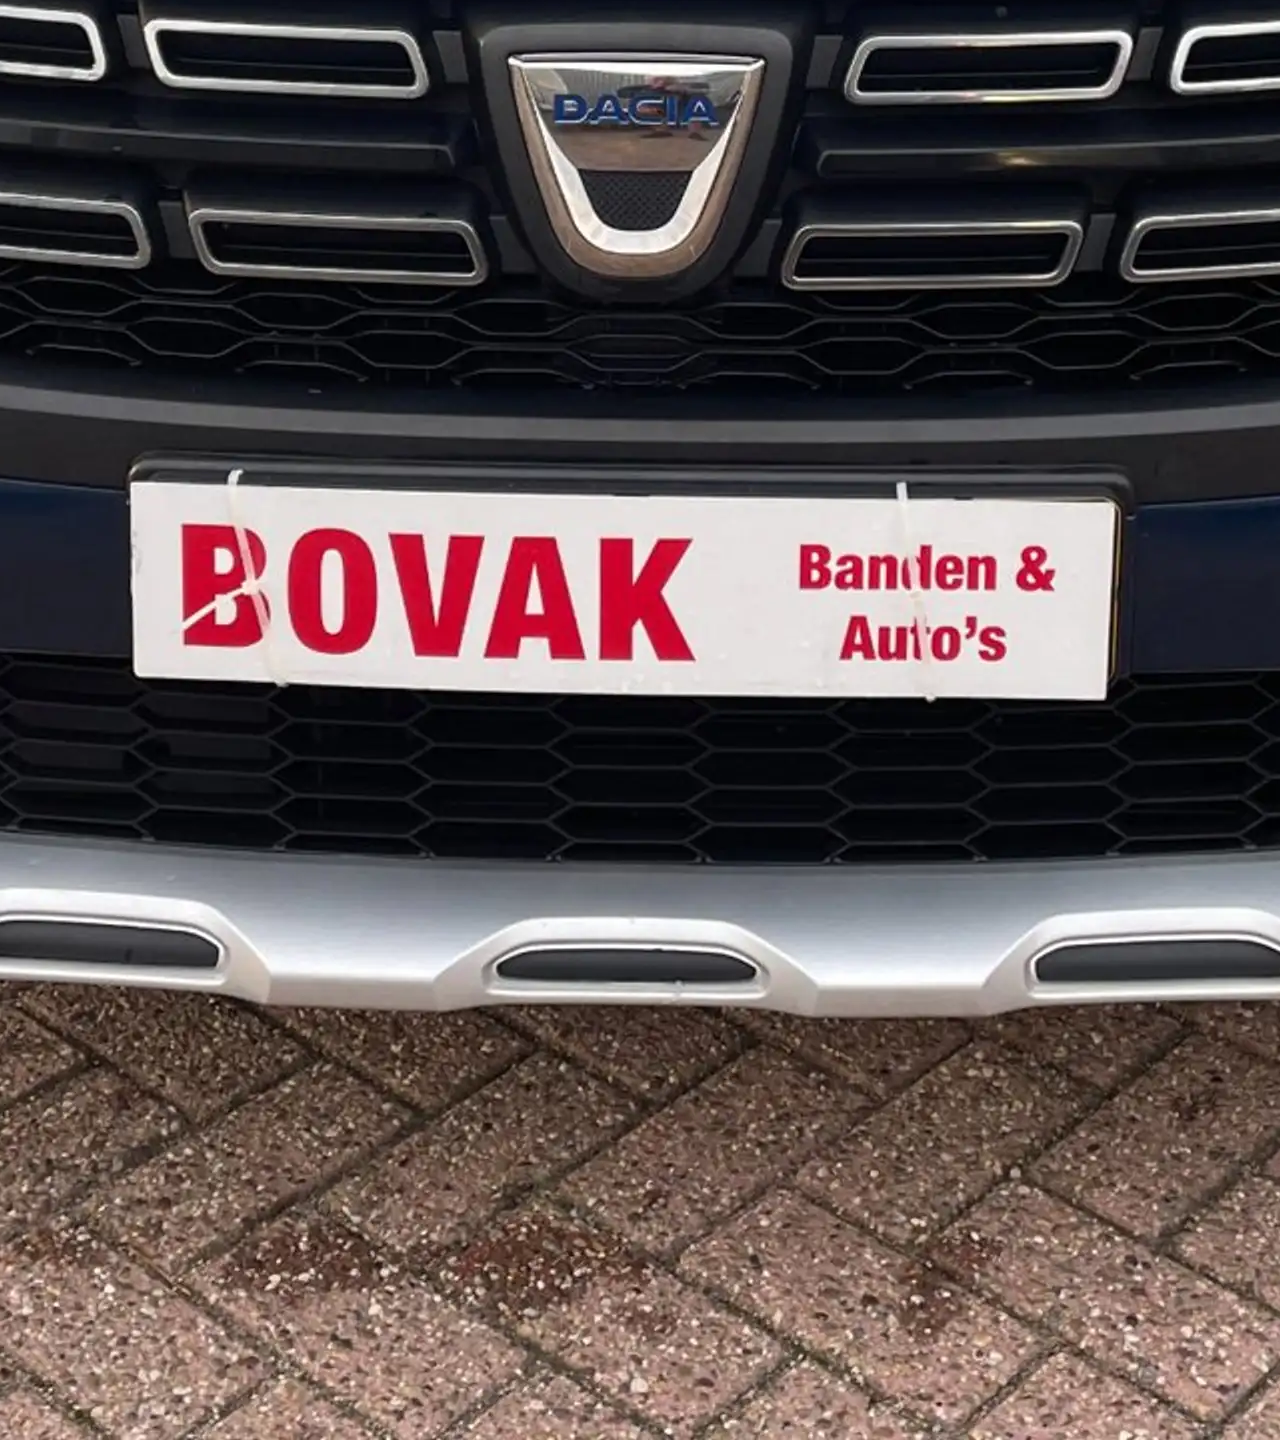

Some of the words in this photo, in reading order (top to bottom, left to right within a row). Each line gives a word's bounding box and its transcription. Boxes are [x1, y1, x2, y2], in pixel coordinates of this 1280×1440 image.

[554, 94, 719, 126] DACIA
[799, 543, 997, 591] Banden
[1016, 545, 1056, 591] &
[181, 523, 696, 661] BOVAK
